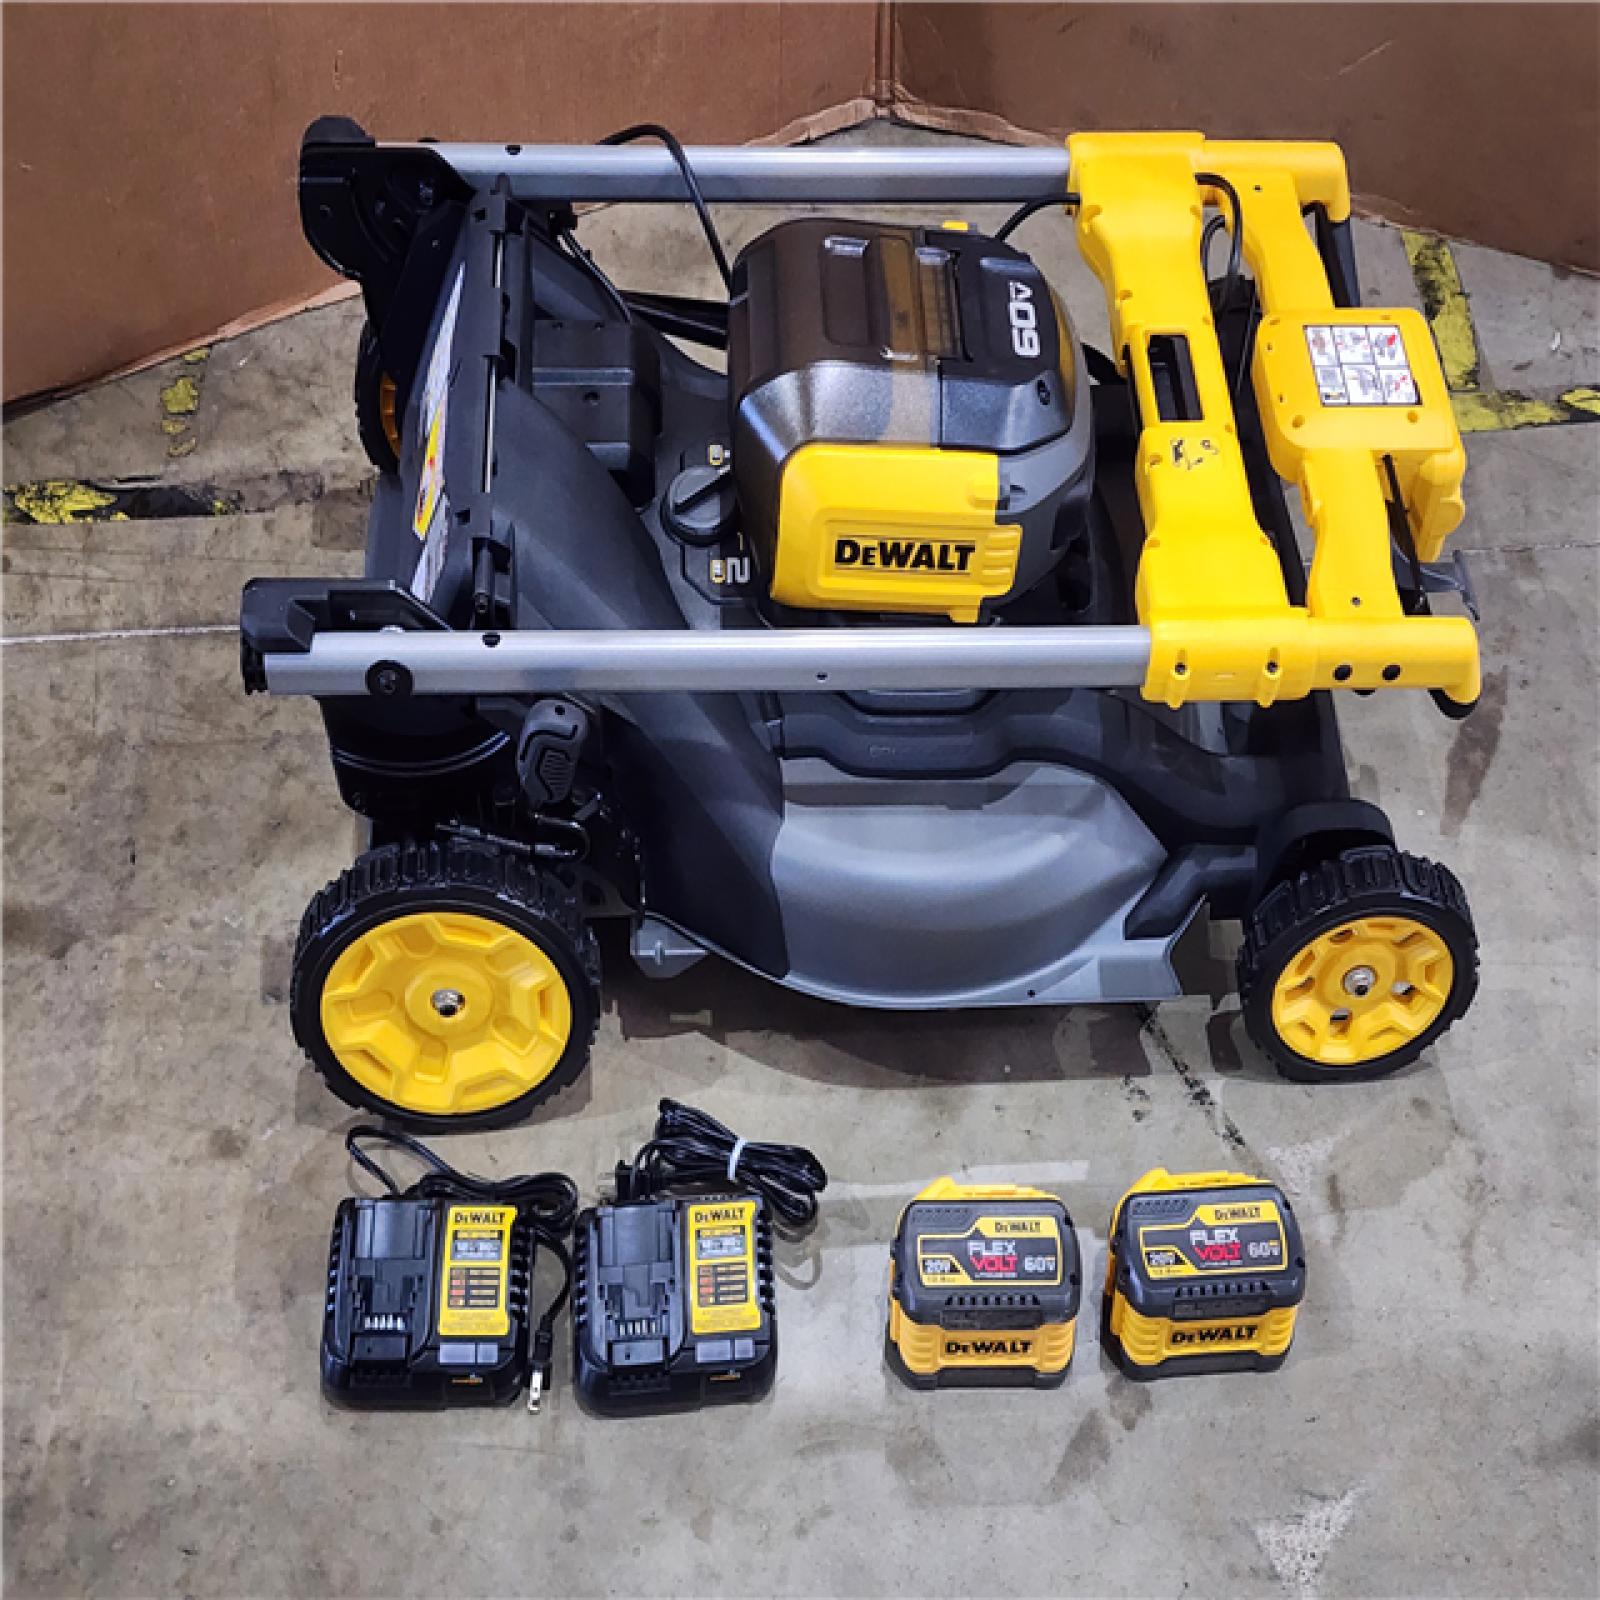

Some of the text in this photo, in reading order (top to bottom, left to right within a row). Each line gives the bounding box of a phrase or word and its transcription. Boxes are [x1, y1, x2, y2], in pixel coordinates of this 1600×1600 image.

[834, 539, 976, 570] DEWALT
[454, 1211, 506, 1224] DEWALT
[694, 1207, 745, 1223] DEWALT
[1214, 1207, 1261, 1220] DEWALT
[994, 1221, 1041, 1233] DEWALT
[1189, 1227, 1240, 1245] FLEX
[967, 1239, 1016, 1256] FLEX
[1193, 1242, 1242, 1262] VOLT
[969, 1255, 1018, 1272] VOLT
[1171, 1326, 1258, 1344] DEWALT
[945, 1340, 1032, 1354] DEWALT
